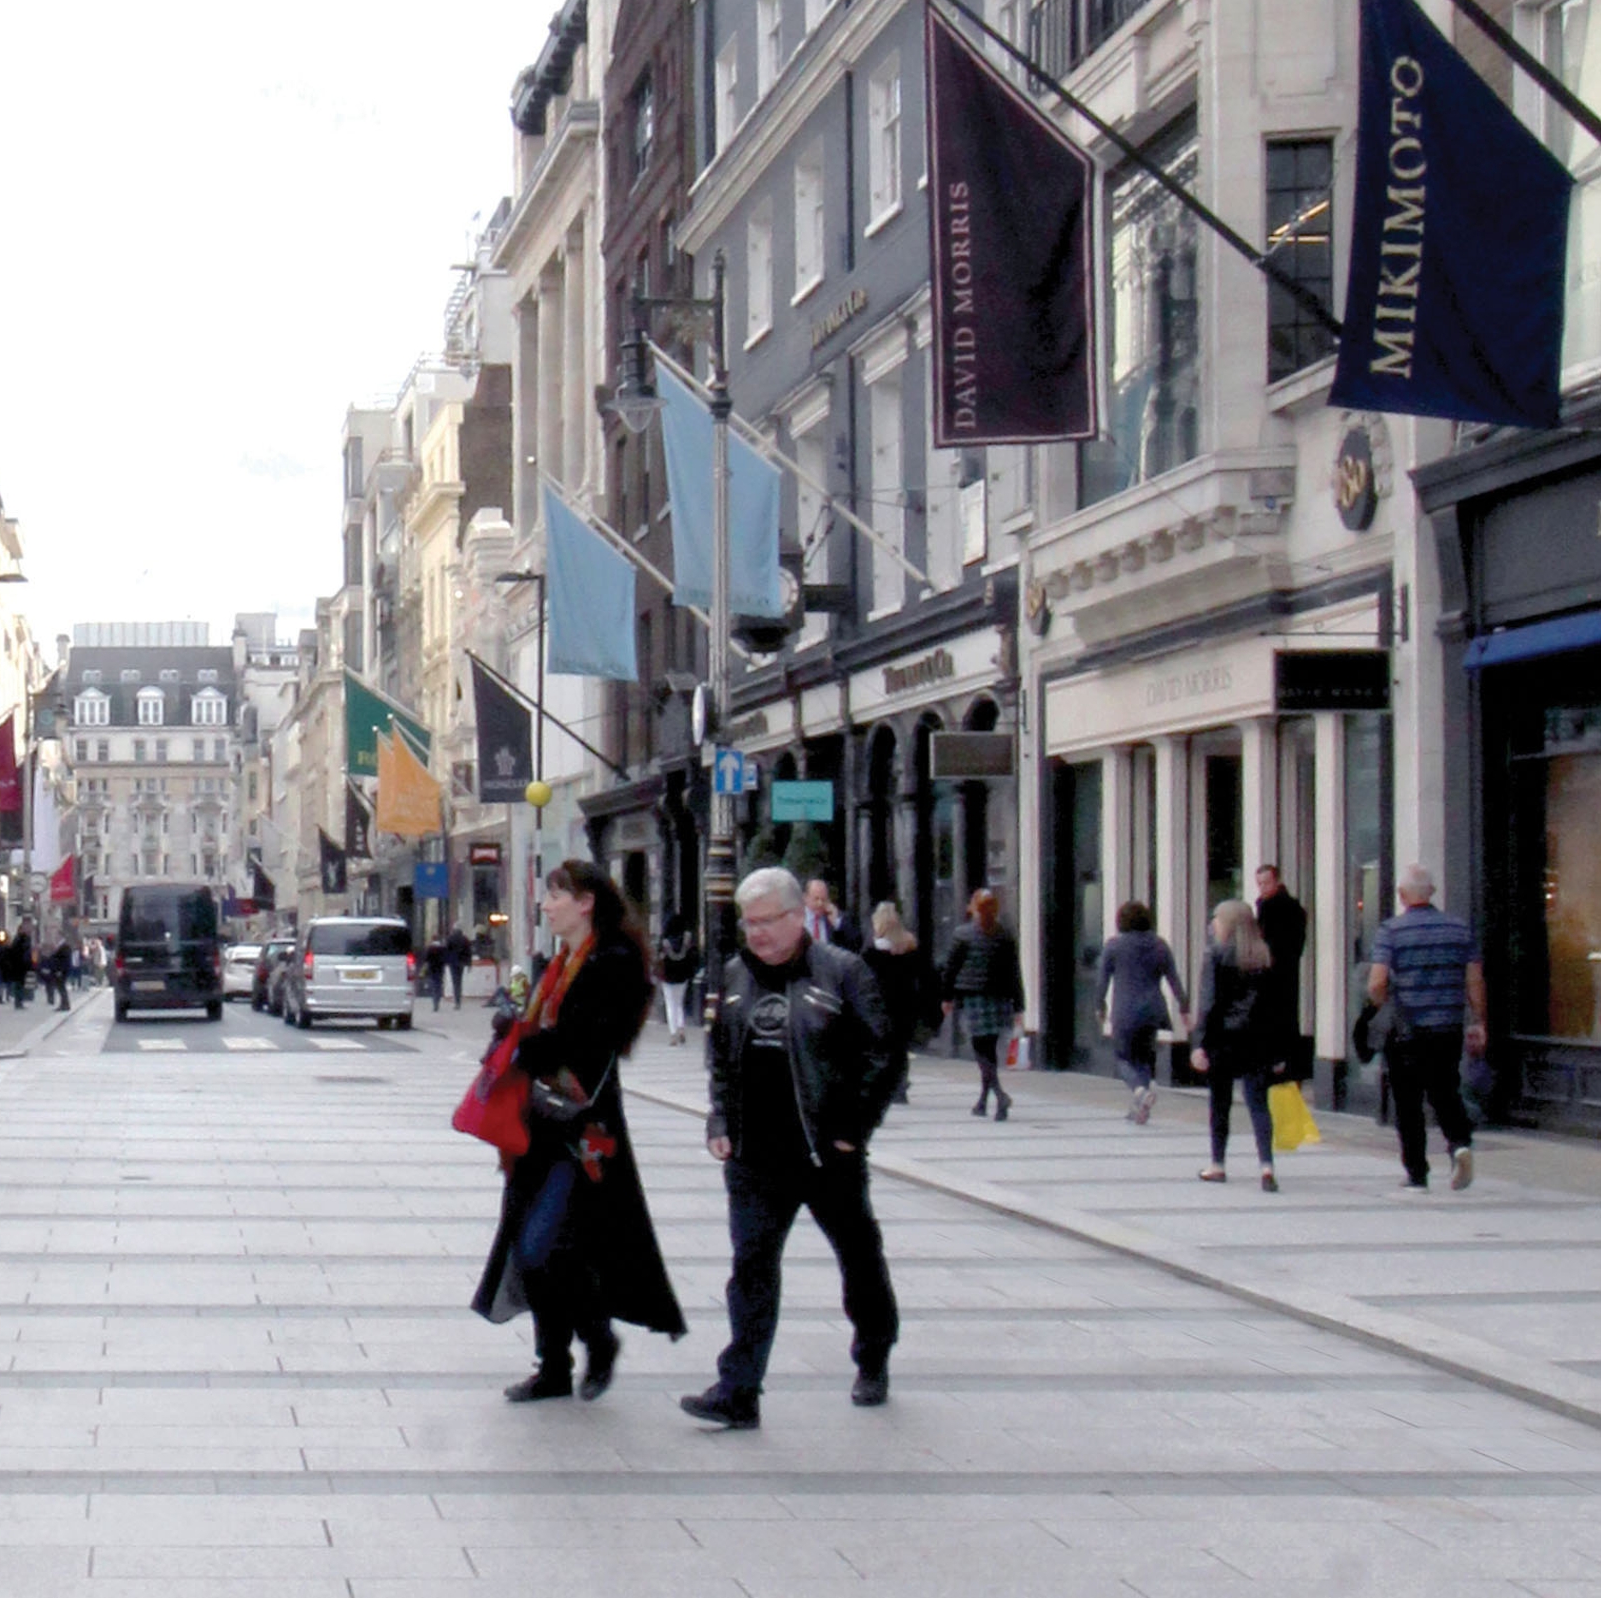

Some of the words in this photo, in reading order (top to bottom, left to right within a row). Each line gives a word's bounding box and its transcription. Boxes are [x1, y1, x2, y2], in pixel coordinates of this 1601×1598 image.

[950, 181, 974, 313] MORRIS
[1370, 55, 1427, 379] MIKIMOTO
[954, 327, 976, 429] DAVID
